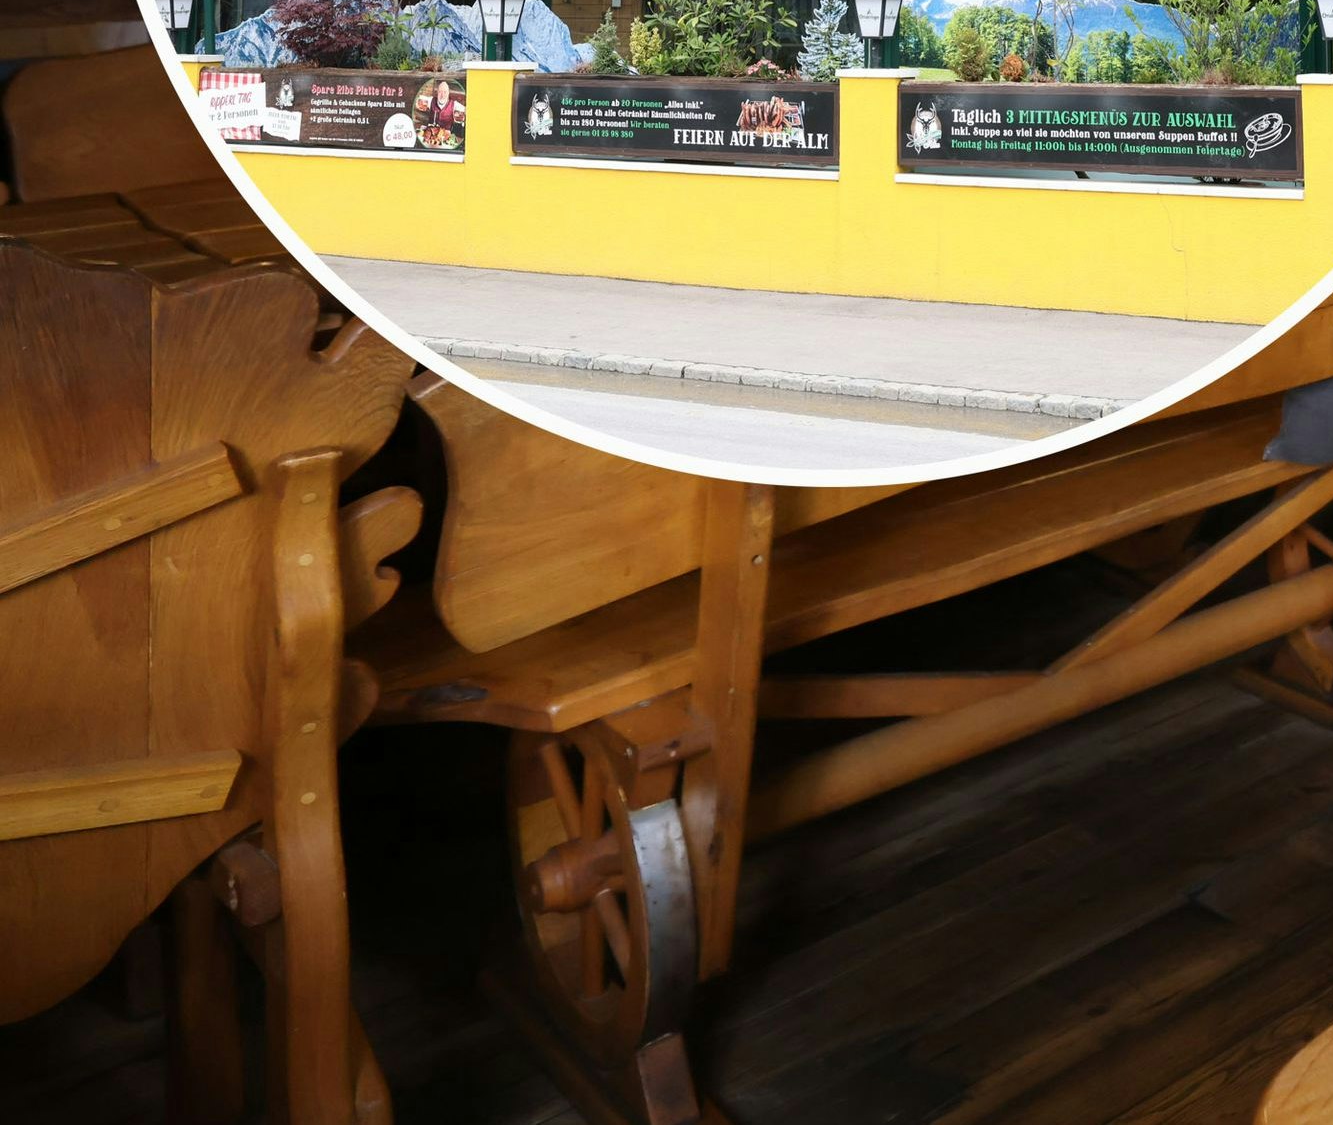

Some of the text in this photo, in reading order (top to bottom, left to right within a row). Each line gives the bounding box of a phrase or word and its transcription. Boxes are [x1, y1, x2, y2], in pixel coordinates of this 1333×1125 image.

[311, 84, 403, 97] Spare Ribs Platte für 2
[574, 99, 586, 107] pro
[587, 98, 609, 106] Person
[611, 99, 620, 107] ab
[621, 99, 630, 107] 20
[632, 99, 662, 108] Personen
[560, 108, 578, 116] Essen
[580, 108, 592, 116] und
[604, 109, 616, 117] alle
[651, 110, 703, 119] Räumlichkeiten
[704, 112, 716, 120] für
[951, 108, 1236, 129] Täglich 3 MITTAGSMENÜS ZUR AUSWAHL
[560, 118, 570, 126] bis
[630, 120, 642, 128] Wir
[643, 120, 670, 129] beraten
[571, 130, 590, 138] gerne
[673, 128, 829, 150] FEIERN AUF DER ALM
[951, 127, 970, 136] inkl.
[973, 127, 1000, 139] Suppe
[1003, 129, 1013, 137] so
[1016, 128, 1033, 138] viel
[1035, 128, 1048, 138] sie
[1051, 128, 1090, 139] möchten
[1093, 130, 1111, 139] von
[1113, 131, 1156, 140] unserem
[1158, 131, 1195, 142] Suppen
[1197, 131, 1228, 142] Buffet
[951, 139, 1246, 157] Montag bis Freitag 11:00h bis 14:00h (Ausgenommen Feiertage)
